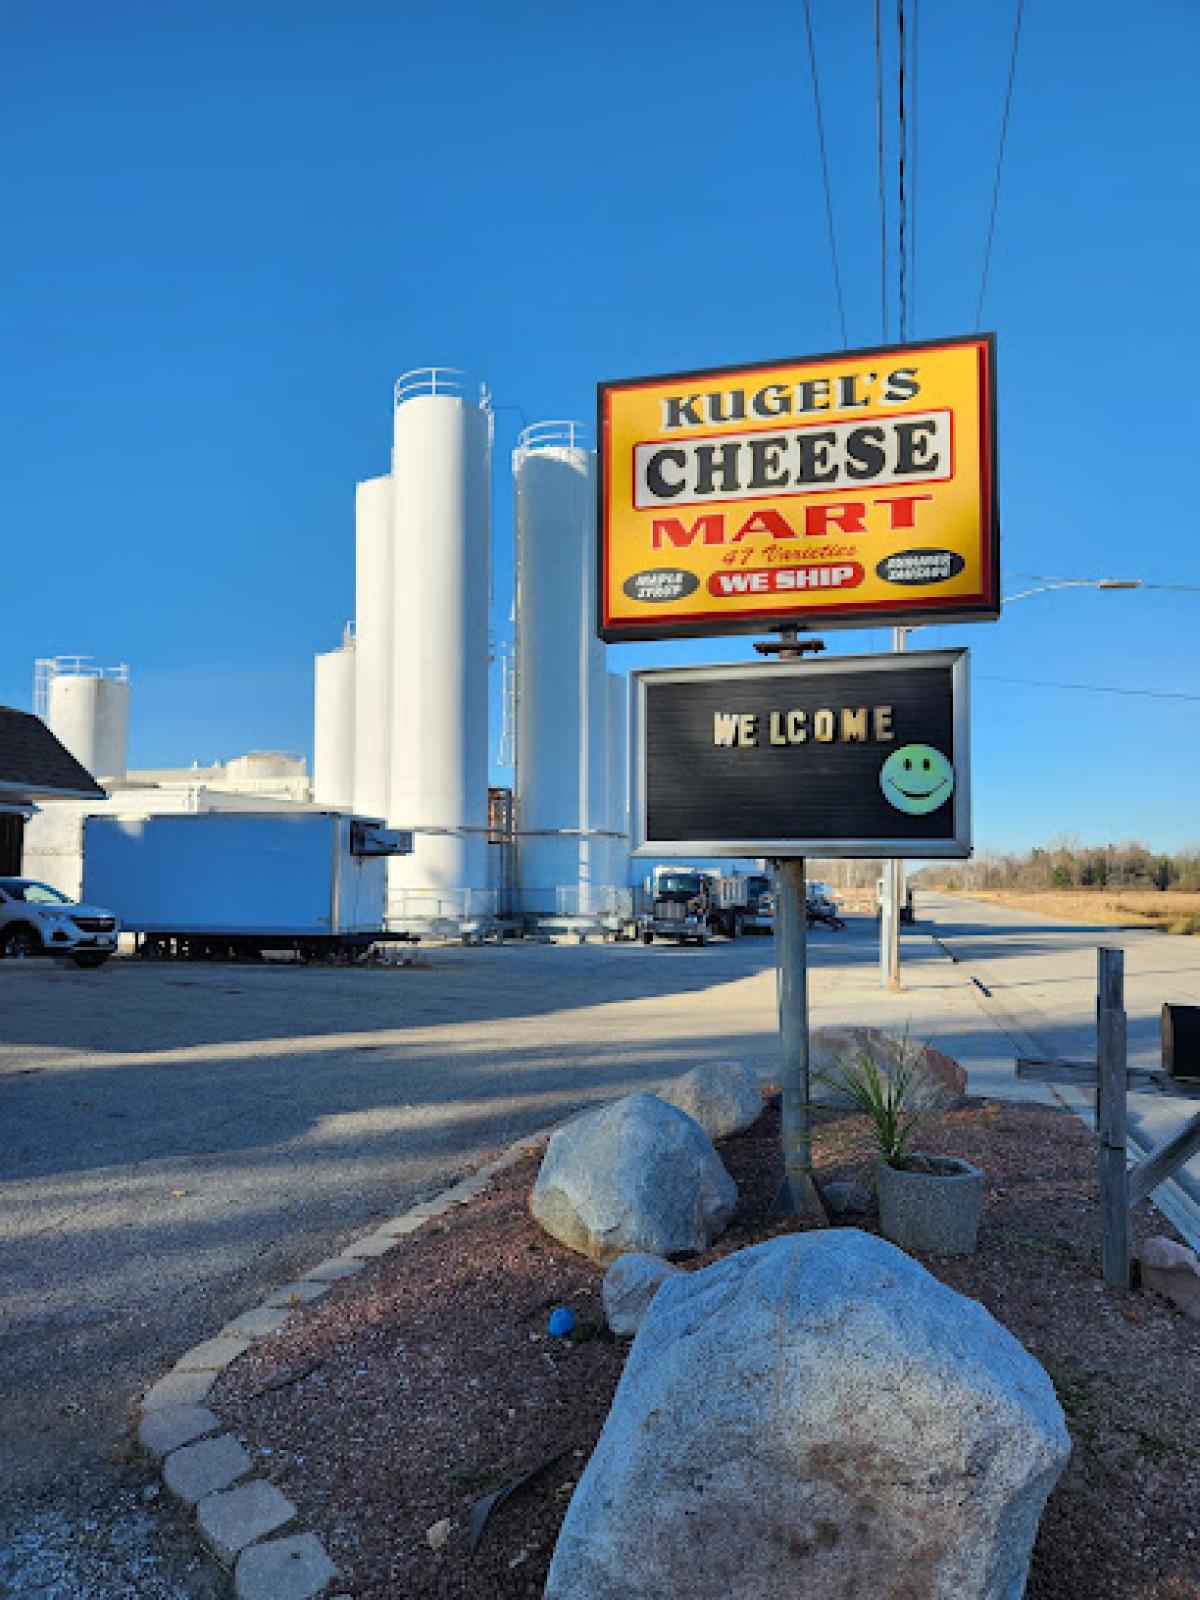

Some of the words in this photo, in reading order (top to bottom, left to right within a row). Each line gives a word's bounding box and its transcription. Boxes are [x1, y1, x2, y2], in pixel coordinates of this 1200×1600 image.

[662, 367, 921, 430] KUGEL'S
[646, 419, 939, 498] CHEESE
[652, 494, 933, 550] MART
[719, 573, 768, 593] WE
[776, 567, 854, 589] SHIP
[762, 544, 858, 563] Varieties
